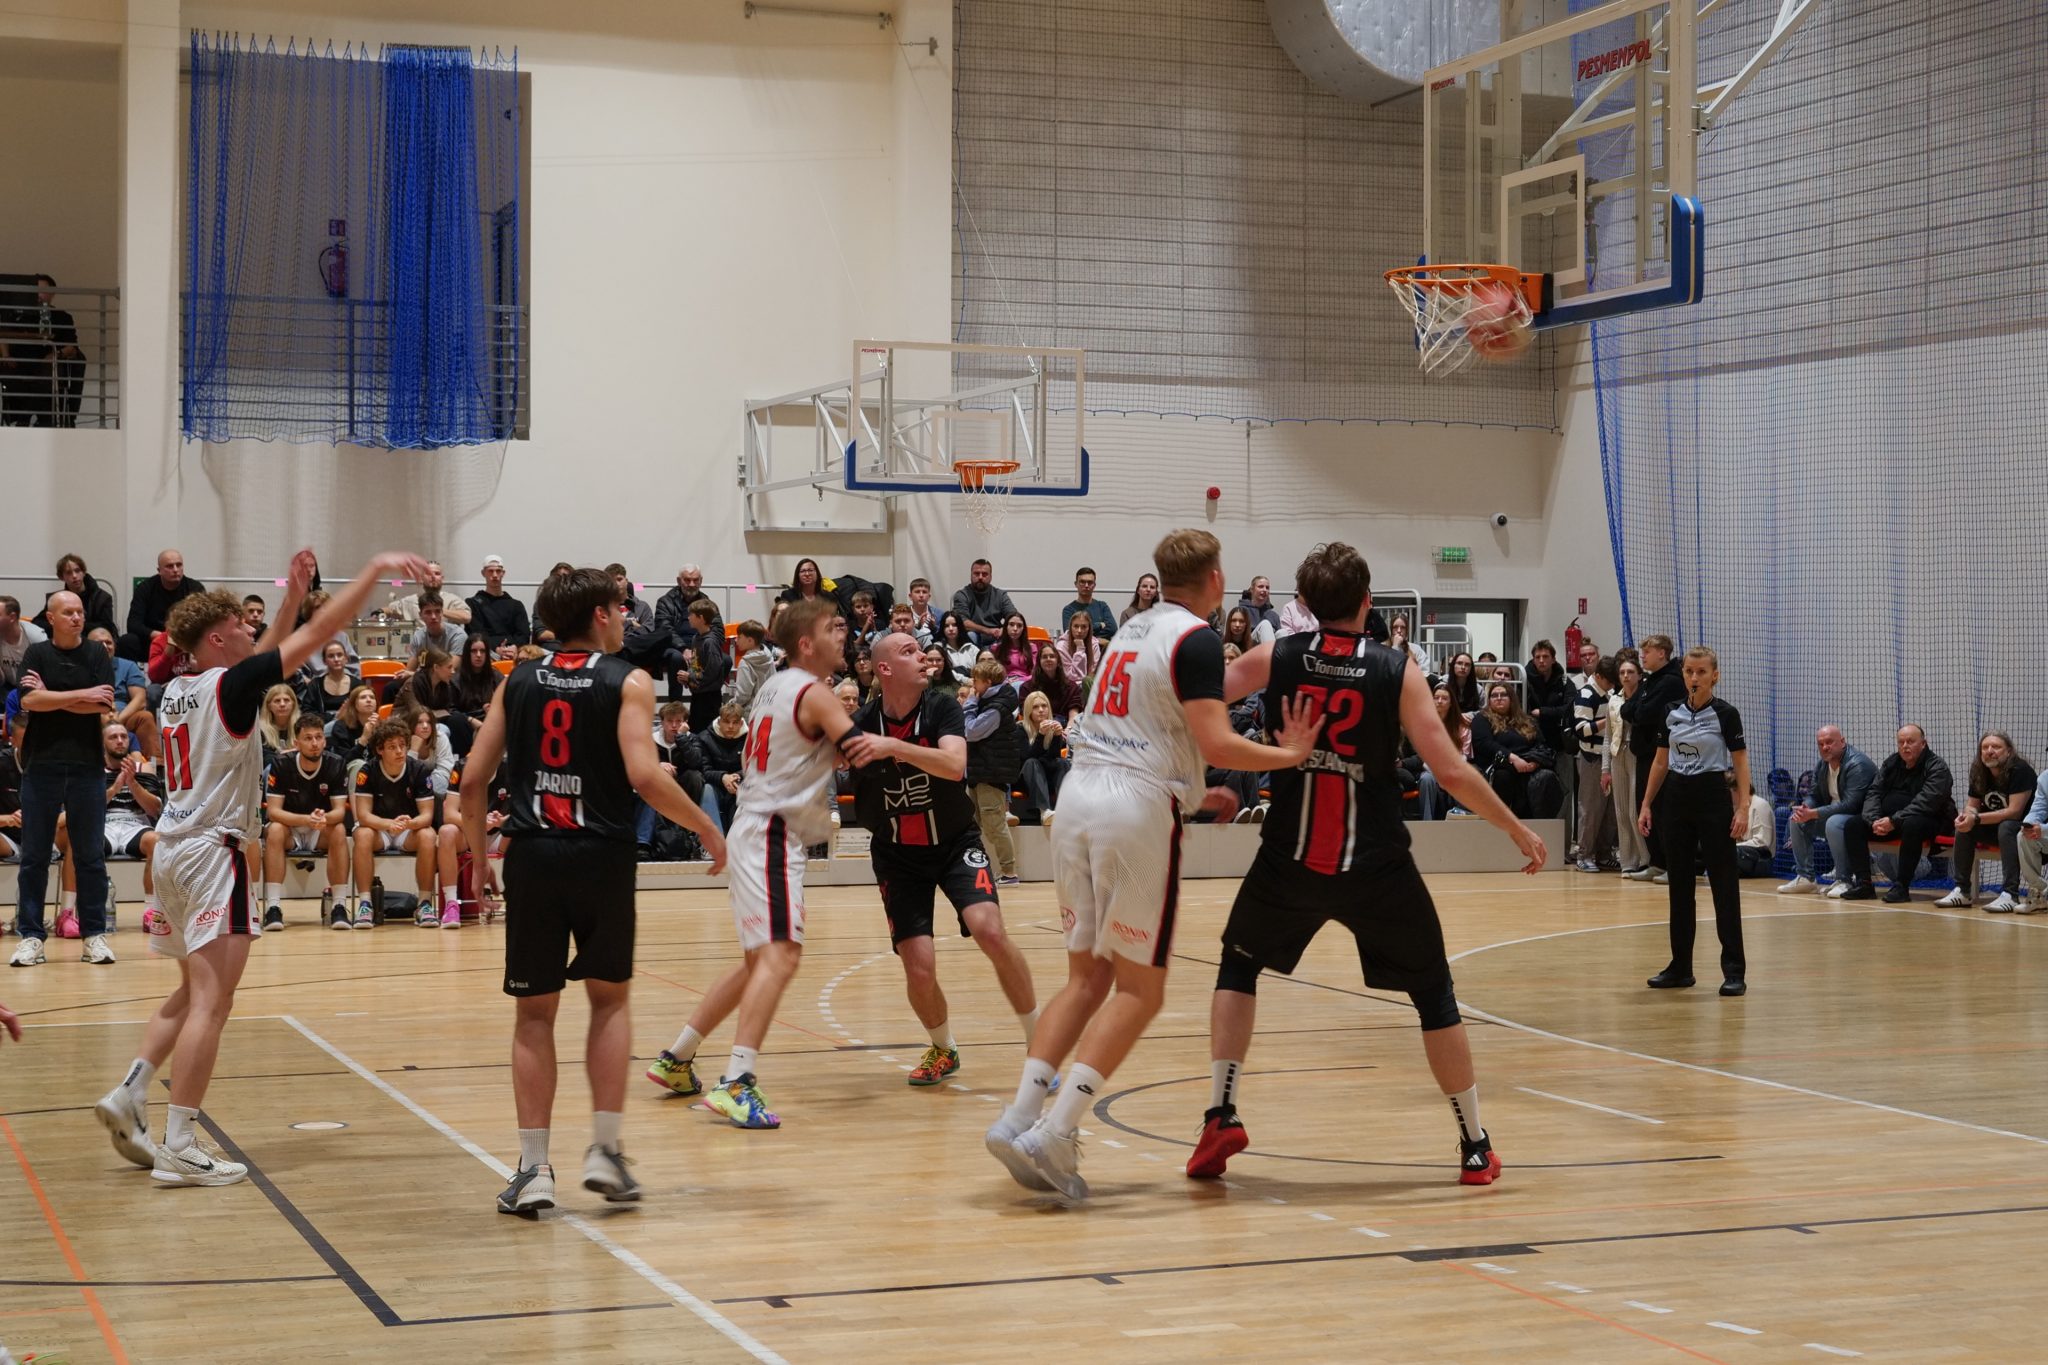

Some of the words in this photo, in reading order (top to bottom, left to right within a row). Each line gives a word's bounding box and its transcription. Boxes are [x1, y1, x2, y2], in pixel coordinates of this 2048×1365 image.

[1577, 39, 1652, 81] PESMENPOL
[1092, 651, 1139, 718] 15
[162, 723, 192, 792] 11
[540, 699, 573, 768] 8
[974, 868, 993, 895] 4
